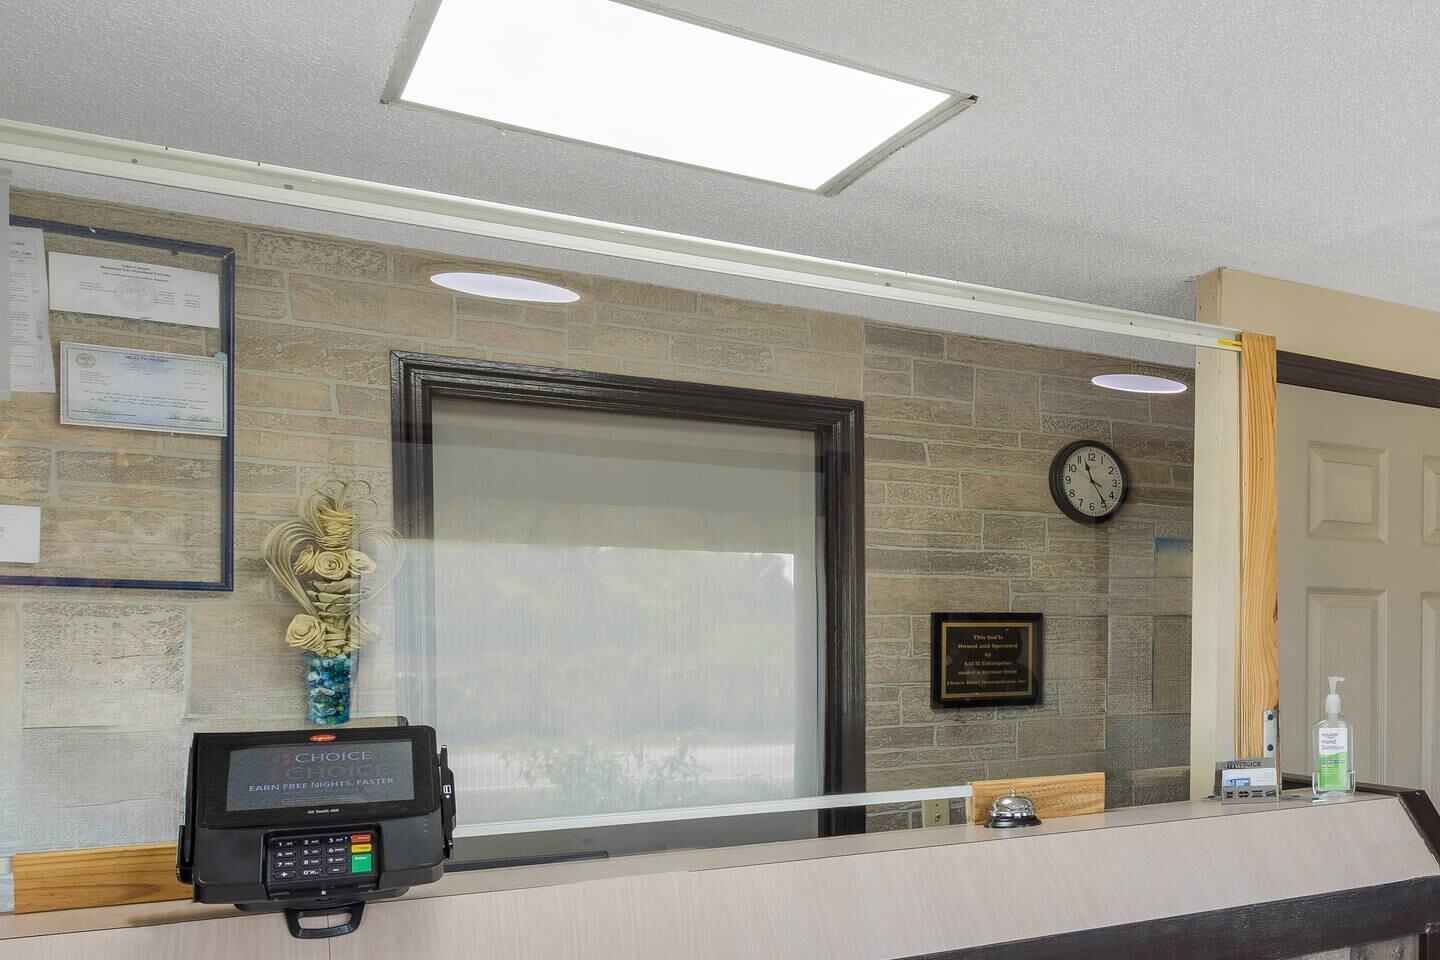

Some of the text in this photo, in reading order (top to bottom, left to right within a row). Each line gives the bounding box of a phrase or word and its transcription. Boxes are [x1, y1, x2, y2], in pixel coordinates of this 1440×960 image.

[1078, 456, 1081, 464] 11
[1088, 453, 1096, 461] 12
[1101, 456, 1103, 464] 1
[1069, 464, 1076, 472] 10
[1108, 466, 1114, 474] 2
[1066, 476, 1071, 484] 9
[1112, 479, 1117, 487] 3
[1069, 489, 1075, 497] 8
[1090, 503, 1095, 511] 6
[295, 751, 372, 763] CHOICE
